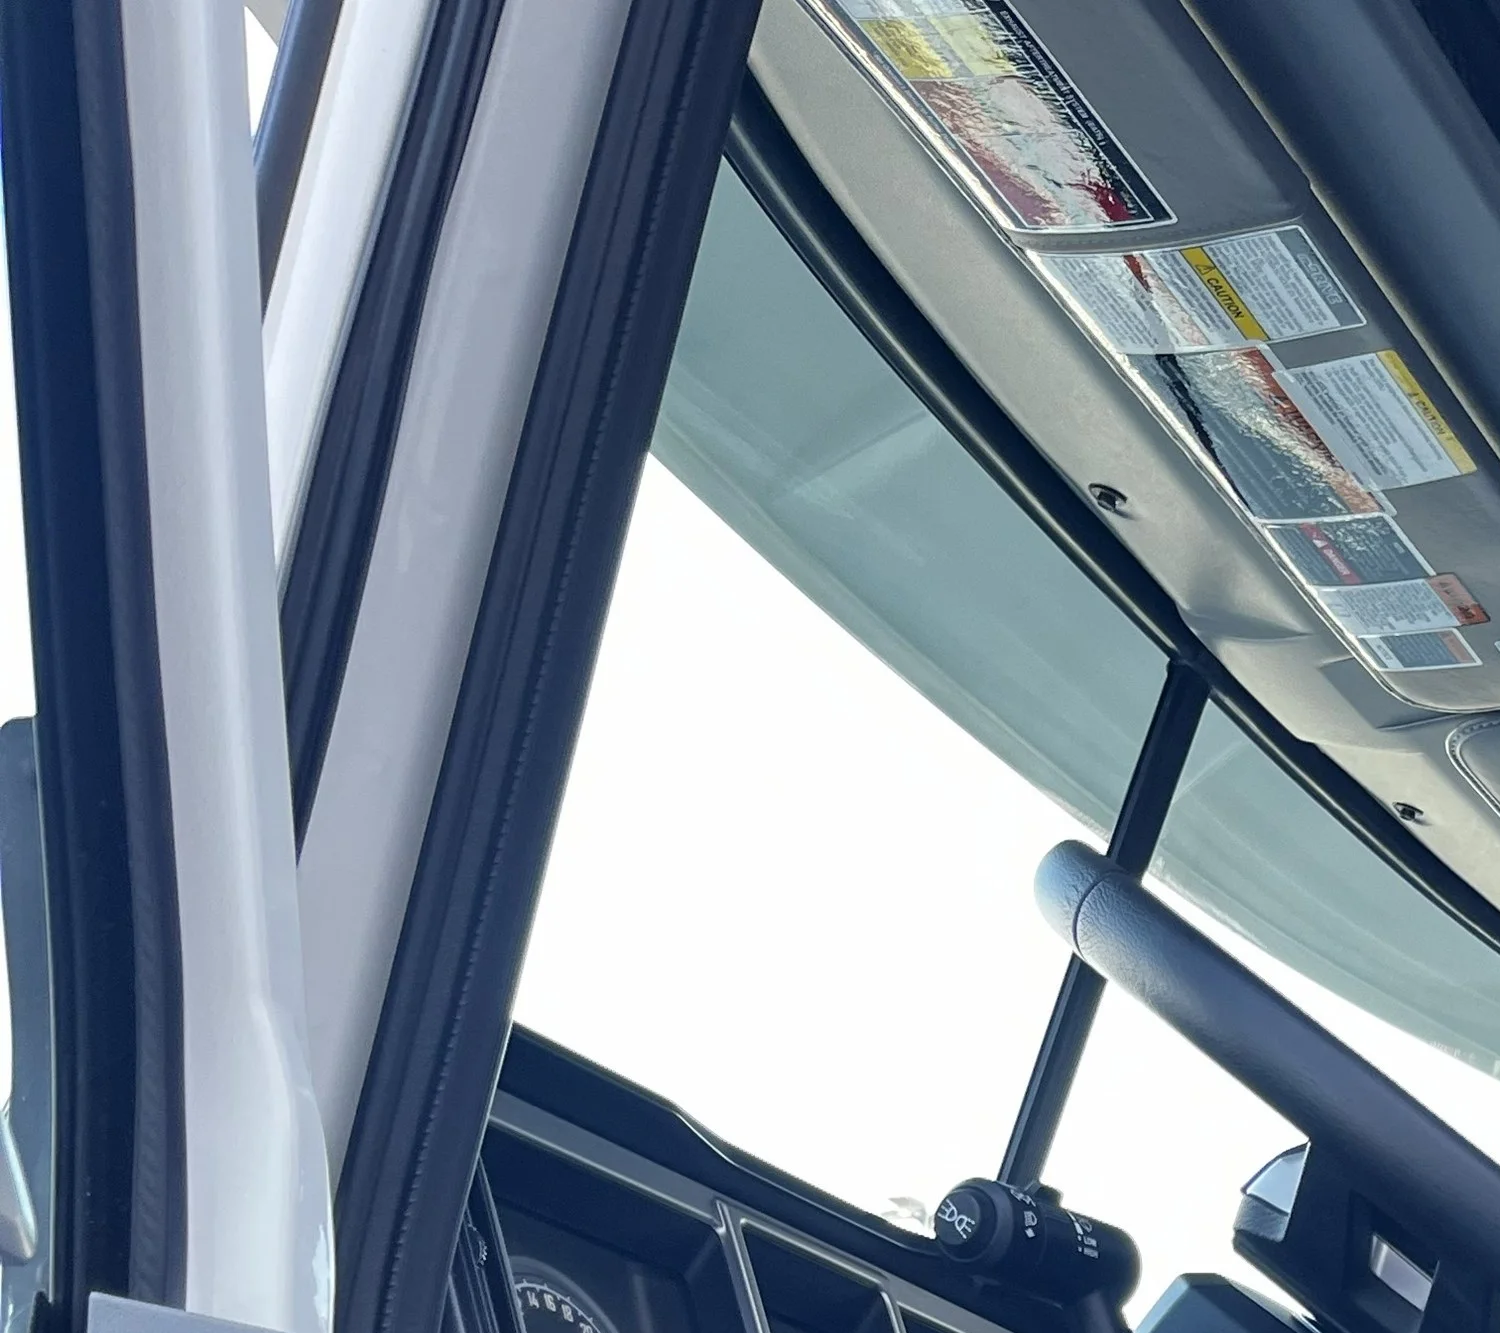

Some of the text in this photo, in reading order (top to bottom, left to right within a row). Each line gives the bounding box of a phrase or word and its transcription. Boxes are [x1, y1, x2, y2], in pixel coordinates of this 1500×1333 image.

[1207, 277, 1244, 319] CAUTION
[526, 1291, 539, 1309] 14
[545, 1295, 557, 1312] 16
[561, 1304, 574, 1323] 18
